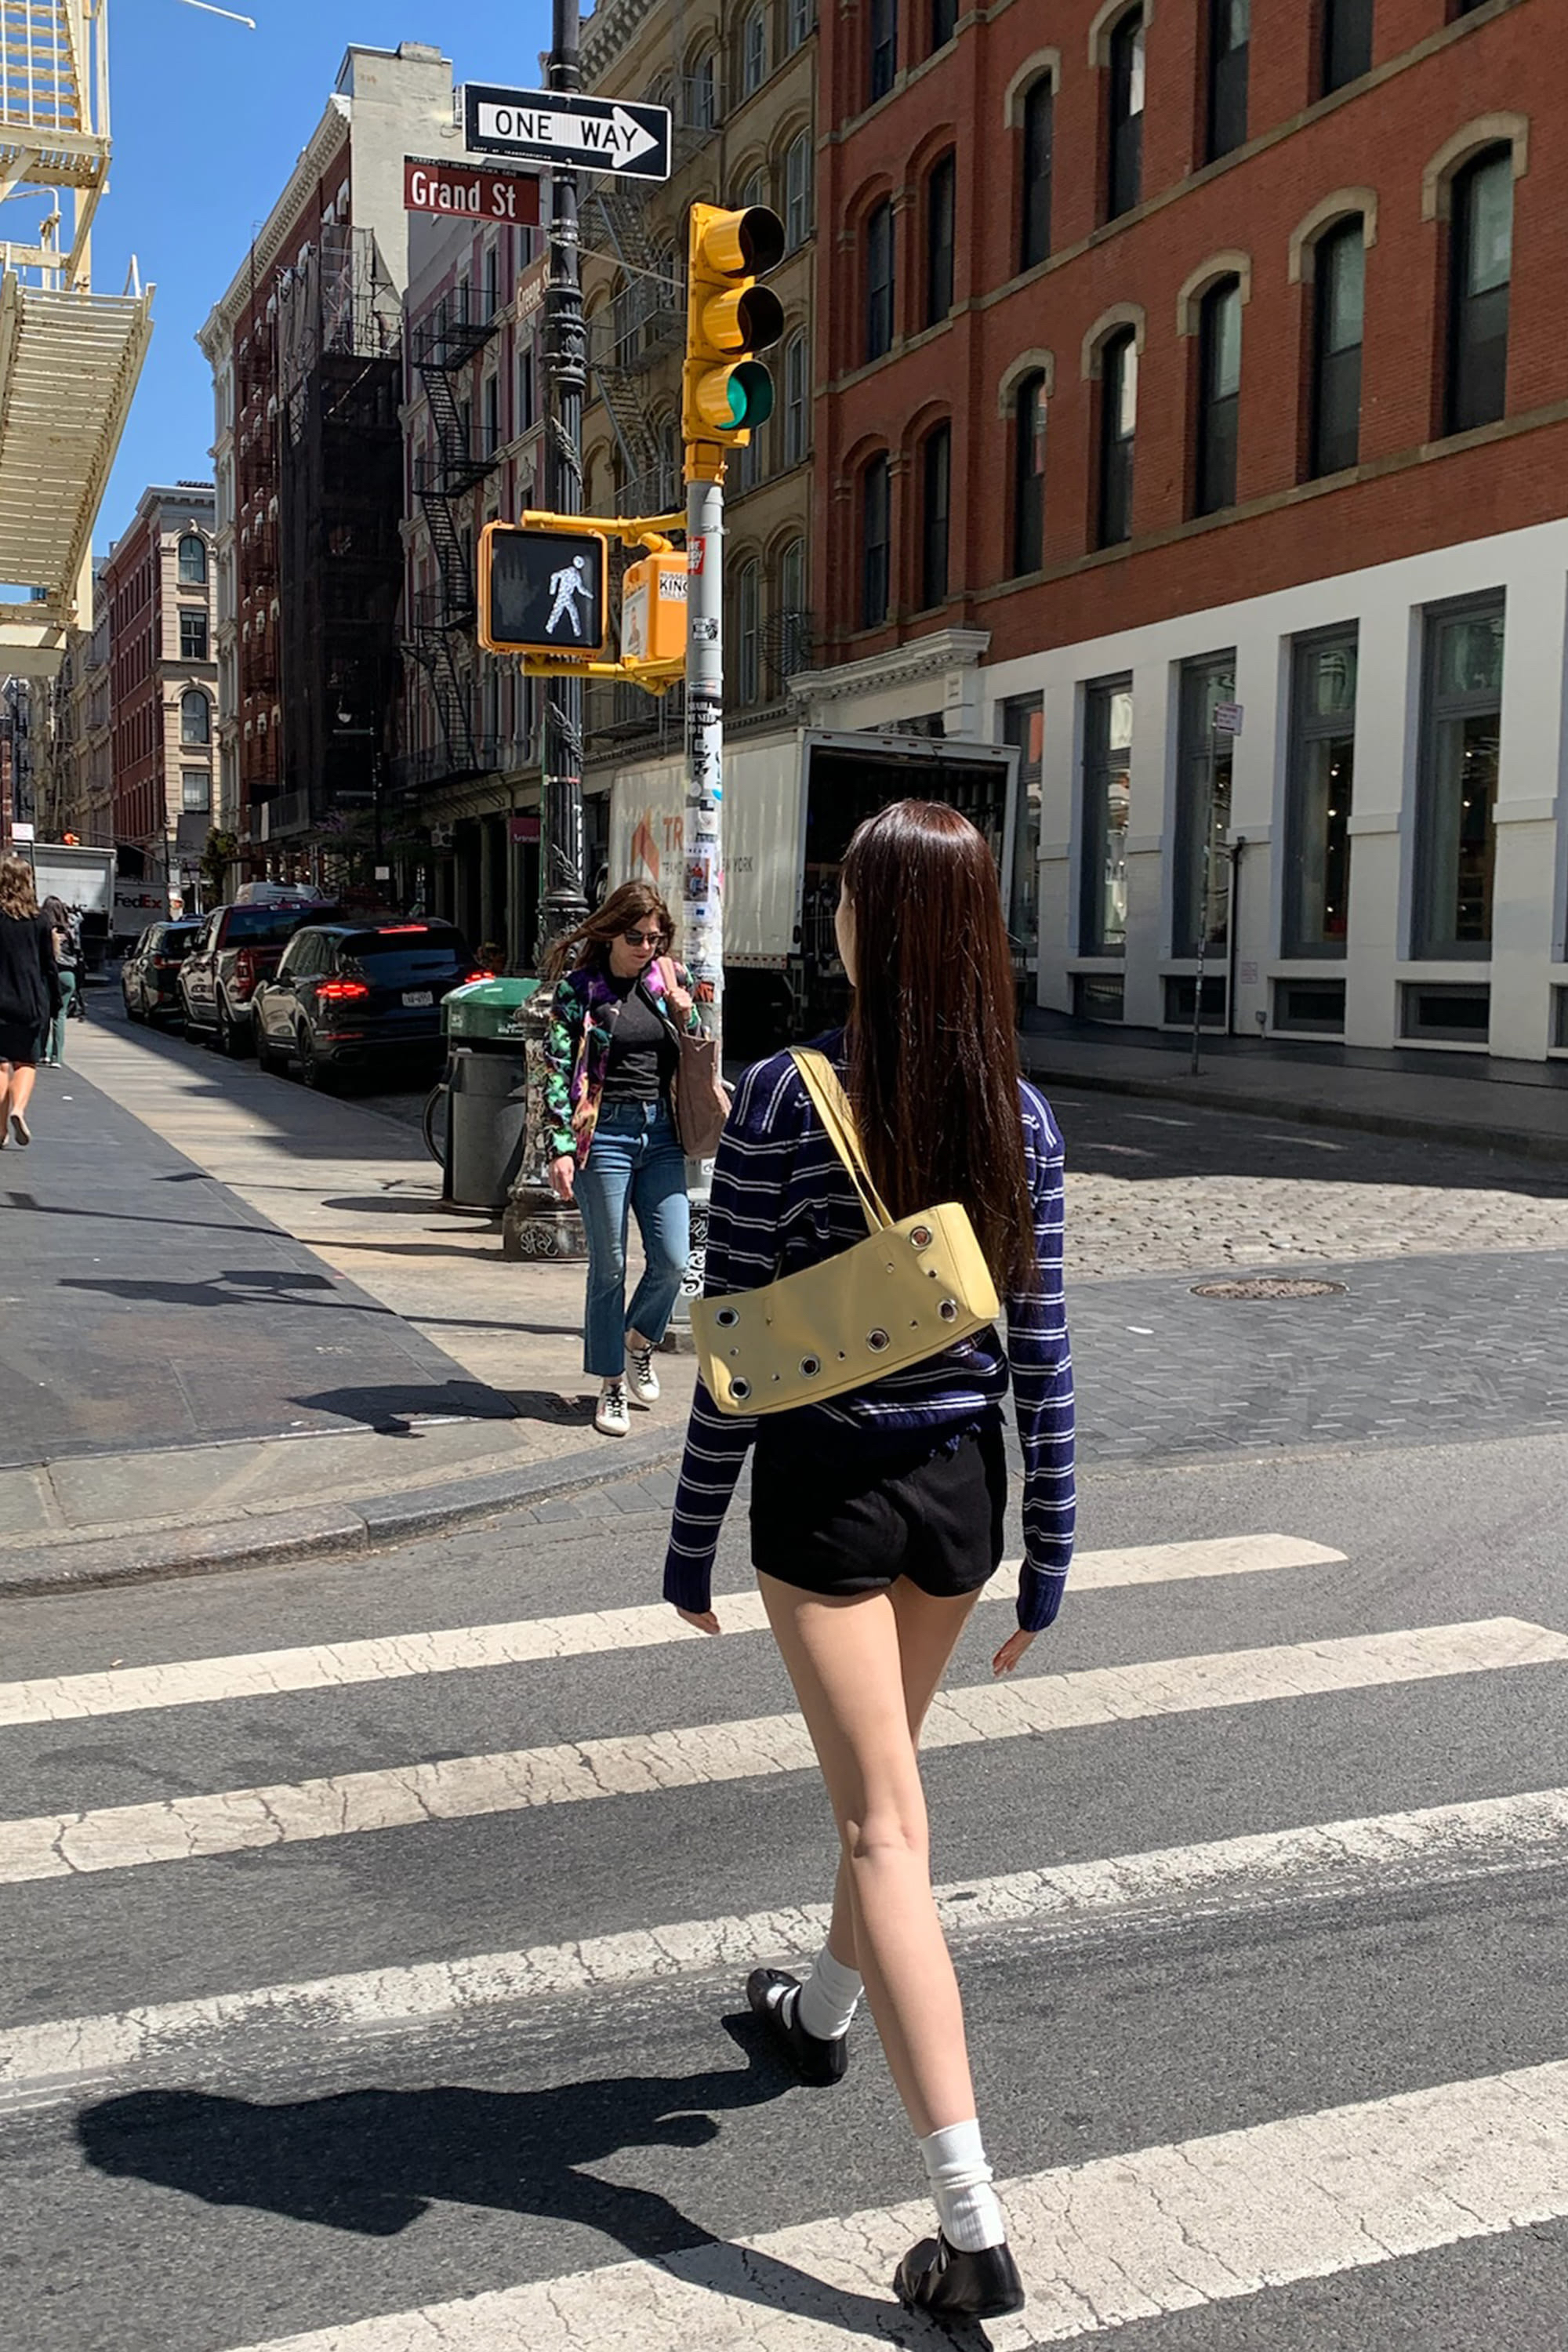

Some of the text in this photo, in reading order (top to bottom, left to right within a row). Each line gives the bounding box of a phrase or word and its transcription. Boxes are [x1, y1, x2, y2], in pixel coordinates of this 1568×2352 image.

[495, 110, 638, 152] ONE WAY
[412, 171, 516, 218] Grand St
[114, 891, 162, 909] FedEx
